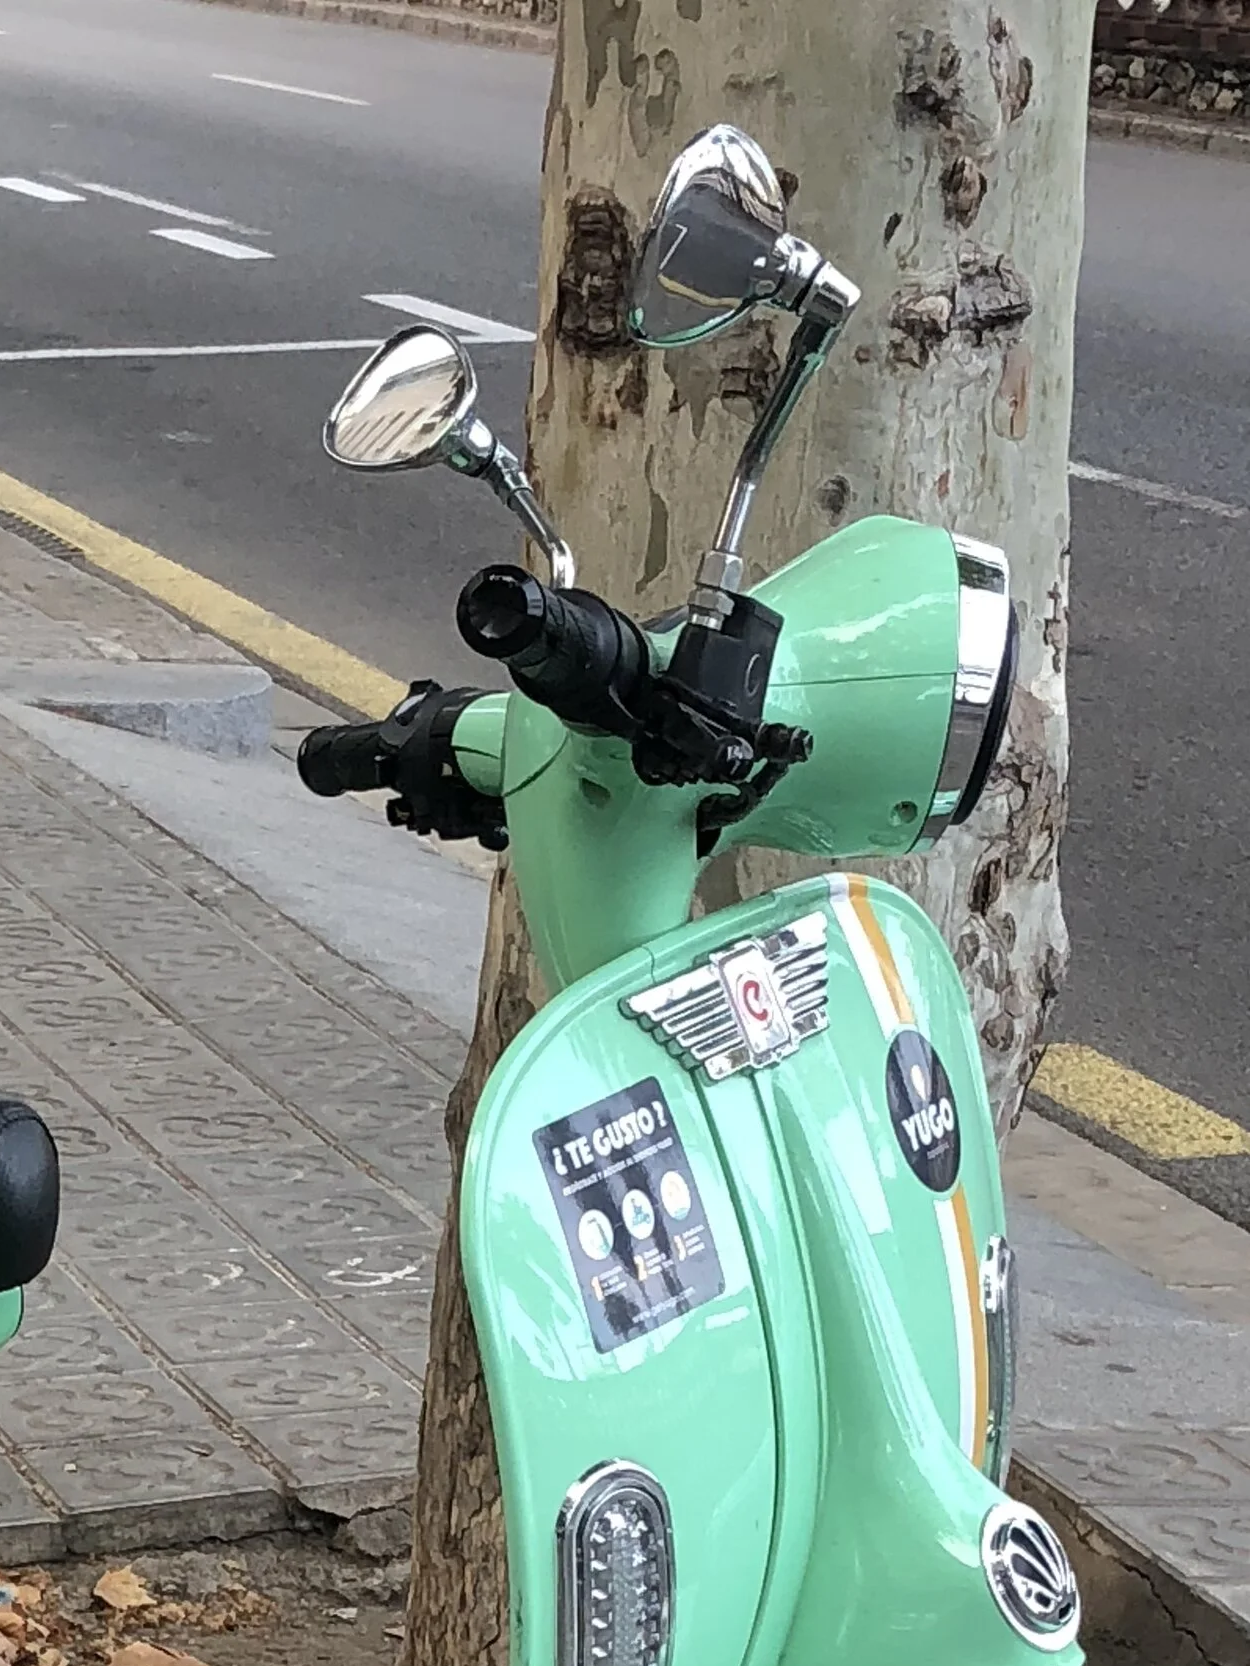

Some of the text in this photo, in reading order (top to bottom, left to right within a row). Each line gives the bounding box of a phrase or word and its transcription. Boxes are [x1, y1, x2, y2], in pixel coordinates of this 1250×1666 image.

[592, 1107, 655, 1157] GUSTO
[901, 1097, 954, 1152] YUGO
[634, 1255, 648, 1281] 2
[591, 1276, 604, 1301] 1
